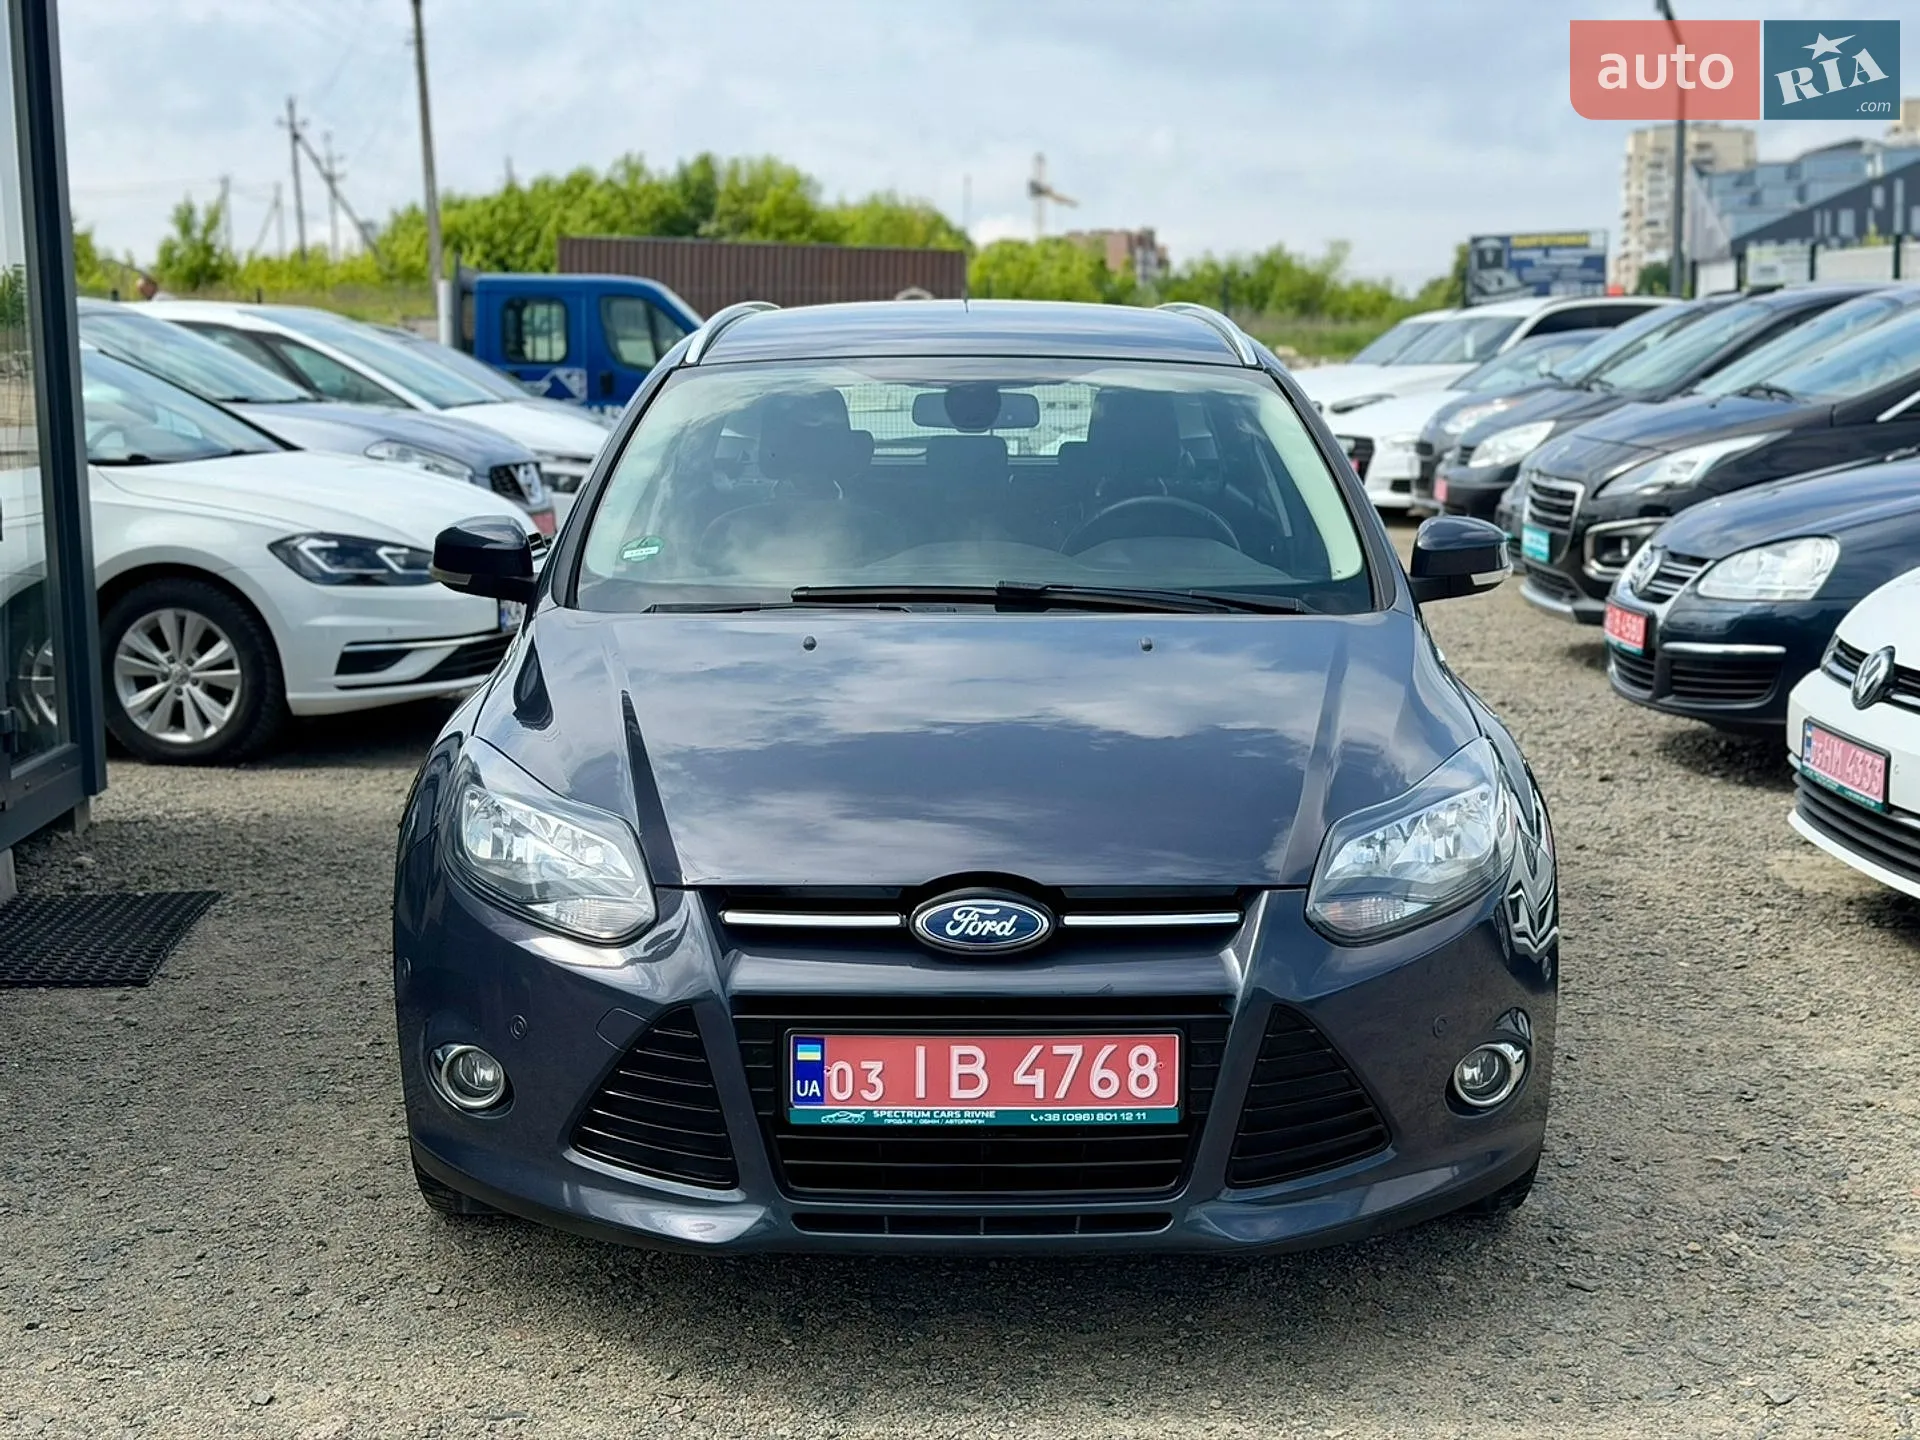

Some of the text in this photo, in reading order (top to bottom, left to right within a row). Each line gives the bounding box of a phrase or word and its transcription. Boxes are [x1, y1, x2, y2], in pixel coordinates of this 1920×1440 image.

[945, 906, 1018, 936] Ford
[829, 1060, 885, 1102] 03
[1012, 1043, 1160, 1100] 4768
[796, 1080, 821, 1097] UA
[873, 1110, 996, 1119] SPECTRUM CARS RIVNE
[1120, 1111, 1134, 1121] 12
[1135, 1111, 1147, 1121] 11
